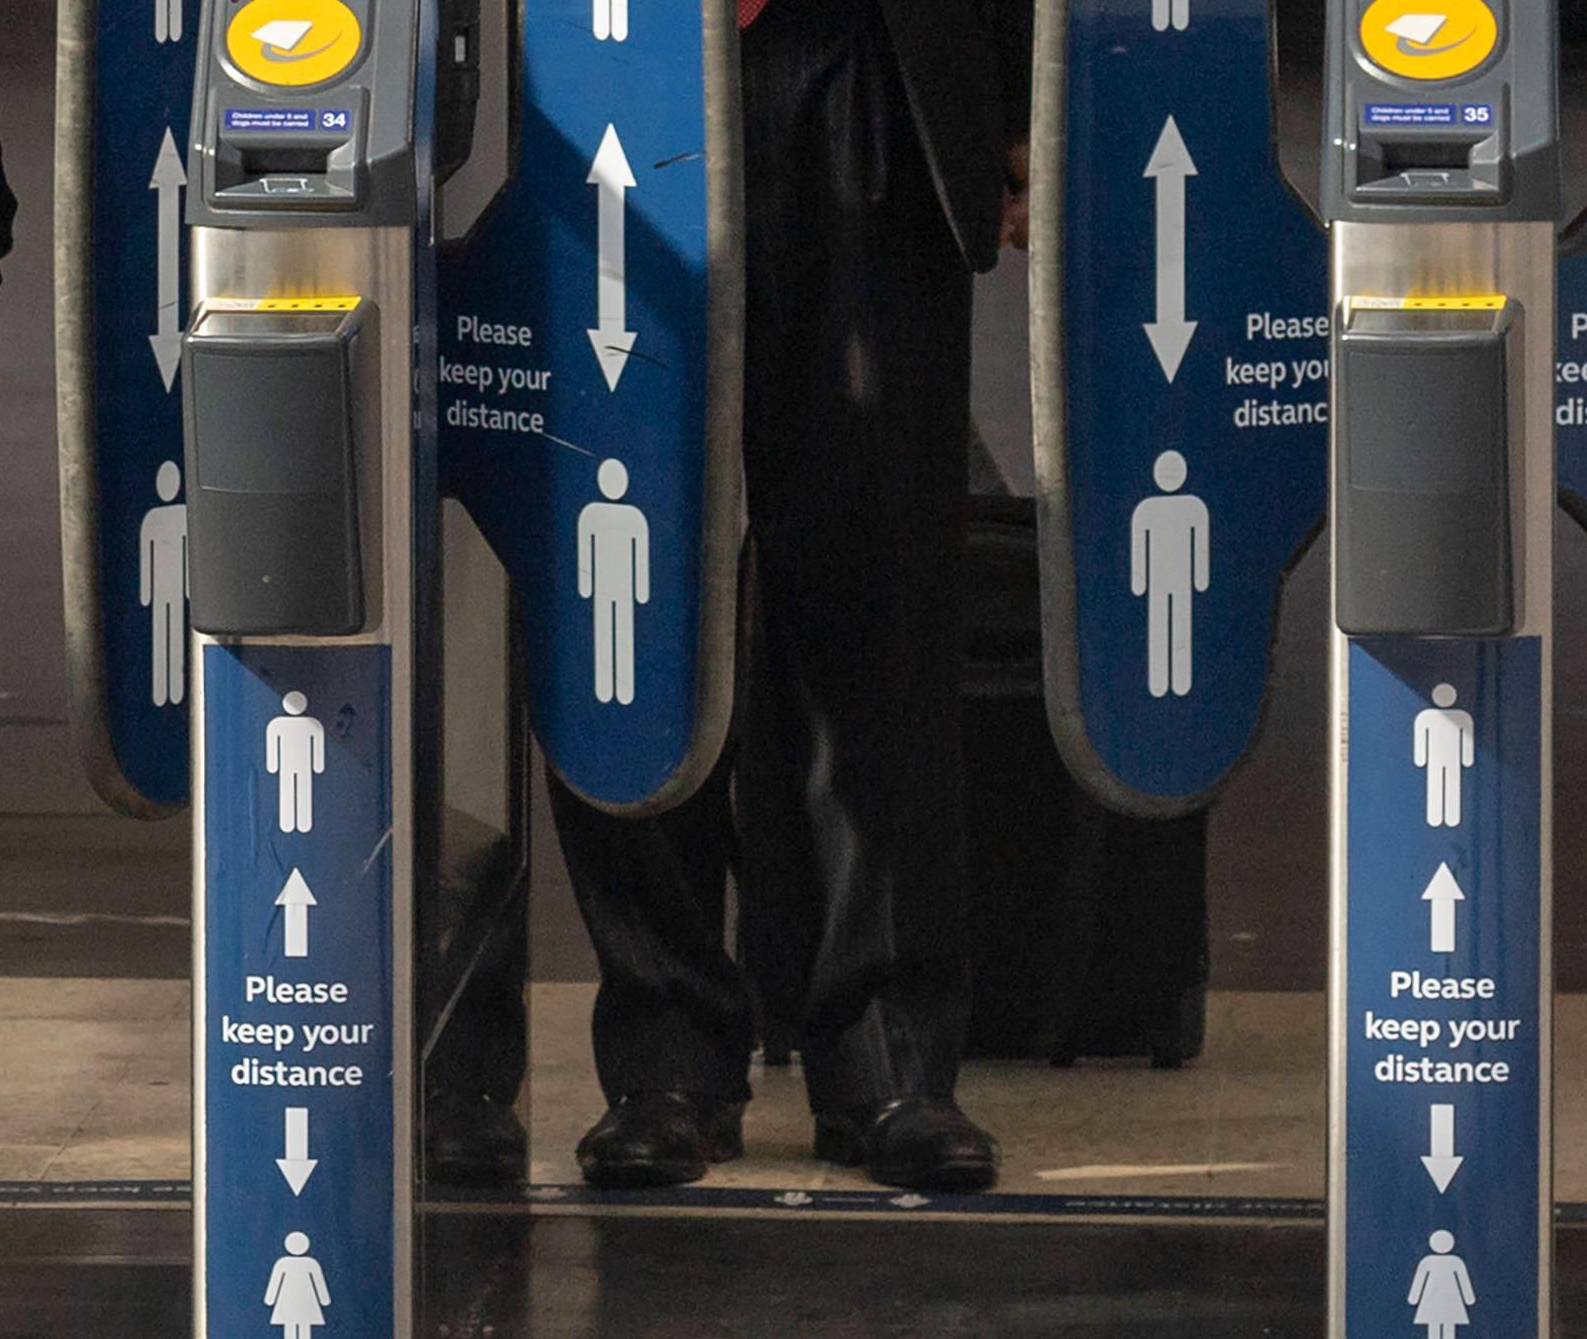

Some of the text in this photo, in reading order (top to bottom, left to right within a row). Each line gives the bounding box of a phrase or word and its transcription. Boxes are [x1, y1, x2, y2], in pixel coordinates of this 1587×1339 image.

[322, 112, 346, 127] 34
[1463, 107, 1489, 122] 35
[457, 315, 533, 346] Please
[1246, 312, 1330, 340] Please
[439, 356, 552, 394] keep your
[1226, 357, 1287, 389] keep
[447, 399, 544, 433] distance
[1234, 400, 1328, 427] distanc
[246, 976, 348, 1003] Please
[1391, 971, 1495, 999] Please
[222, 1016, 374, 1052] keep your
[1365, 1011, 1521, 1048] keep your
[231, 1058, 363, 1086] distance
[1375, 1054, 1510, 1082] distance
